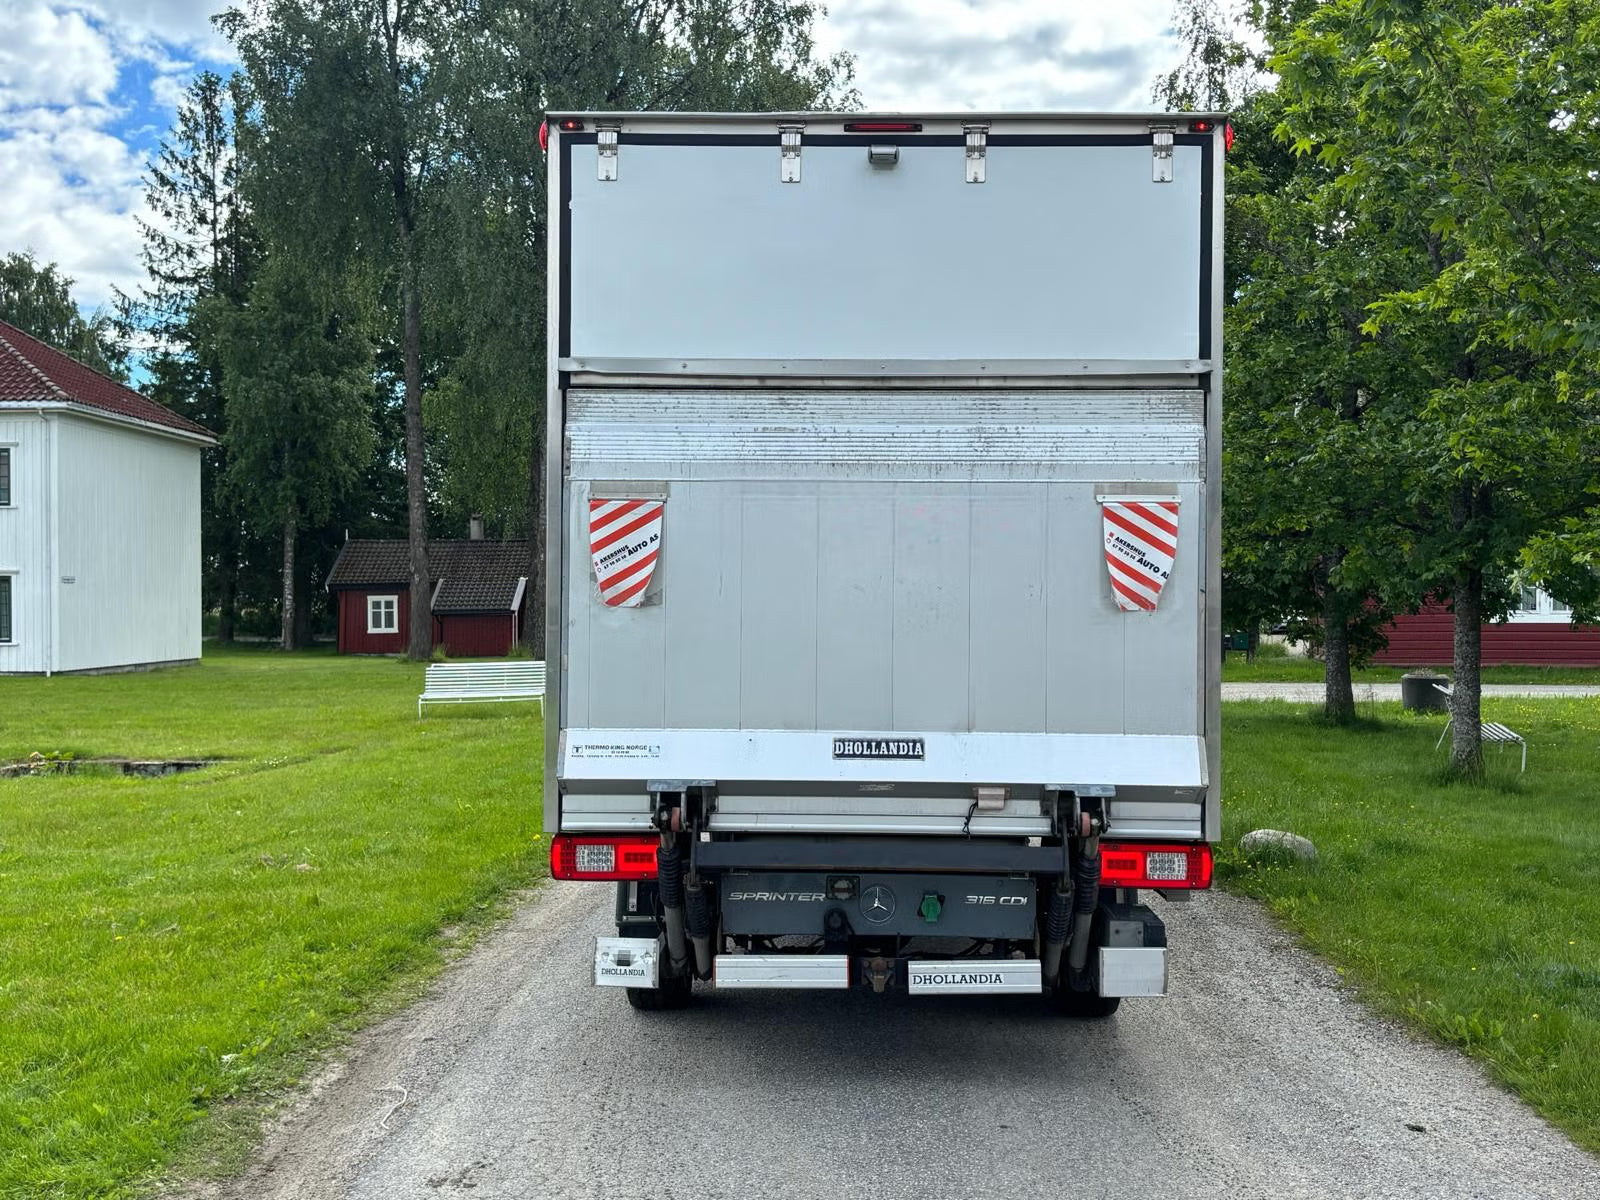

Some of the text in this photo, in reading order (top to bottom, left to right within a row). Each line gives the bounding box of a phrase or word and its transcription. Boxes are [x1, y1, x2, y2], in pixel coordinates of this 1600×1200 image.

[627, 533, 659, 556] AUTO AS
[1114, 536, 1146, 557] AKERSHUS
[600, 545, 630, 564] AKERSHUS
[1137, 557, 1160, 573] AUTO
[834, 741, 923, 755] DHOLLANDIA
[728, 892, 826, 901] SPRINTER
[965, 895, 1028, 906] 316 CDI
[601, 968, 645, 976] DHOLLANDIA
[912, 974, 1003, 984] DHOLLANDIA
